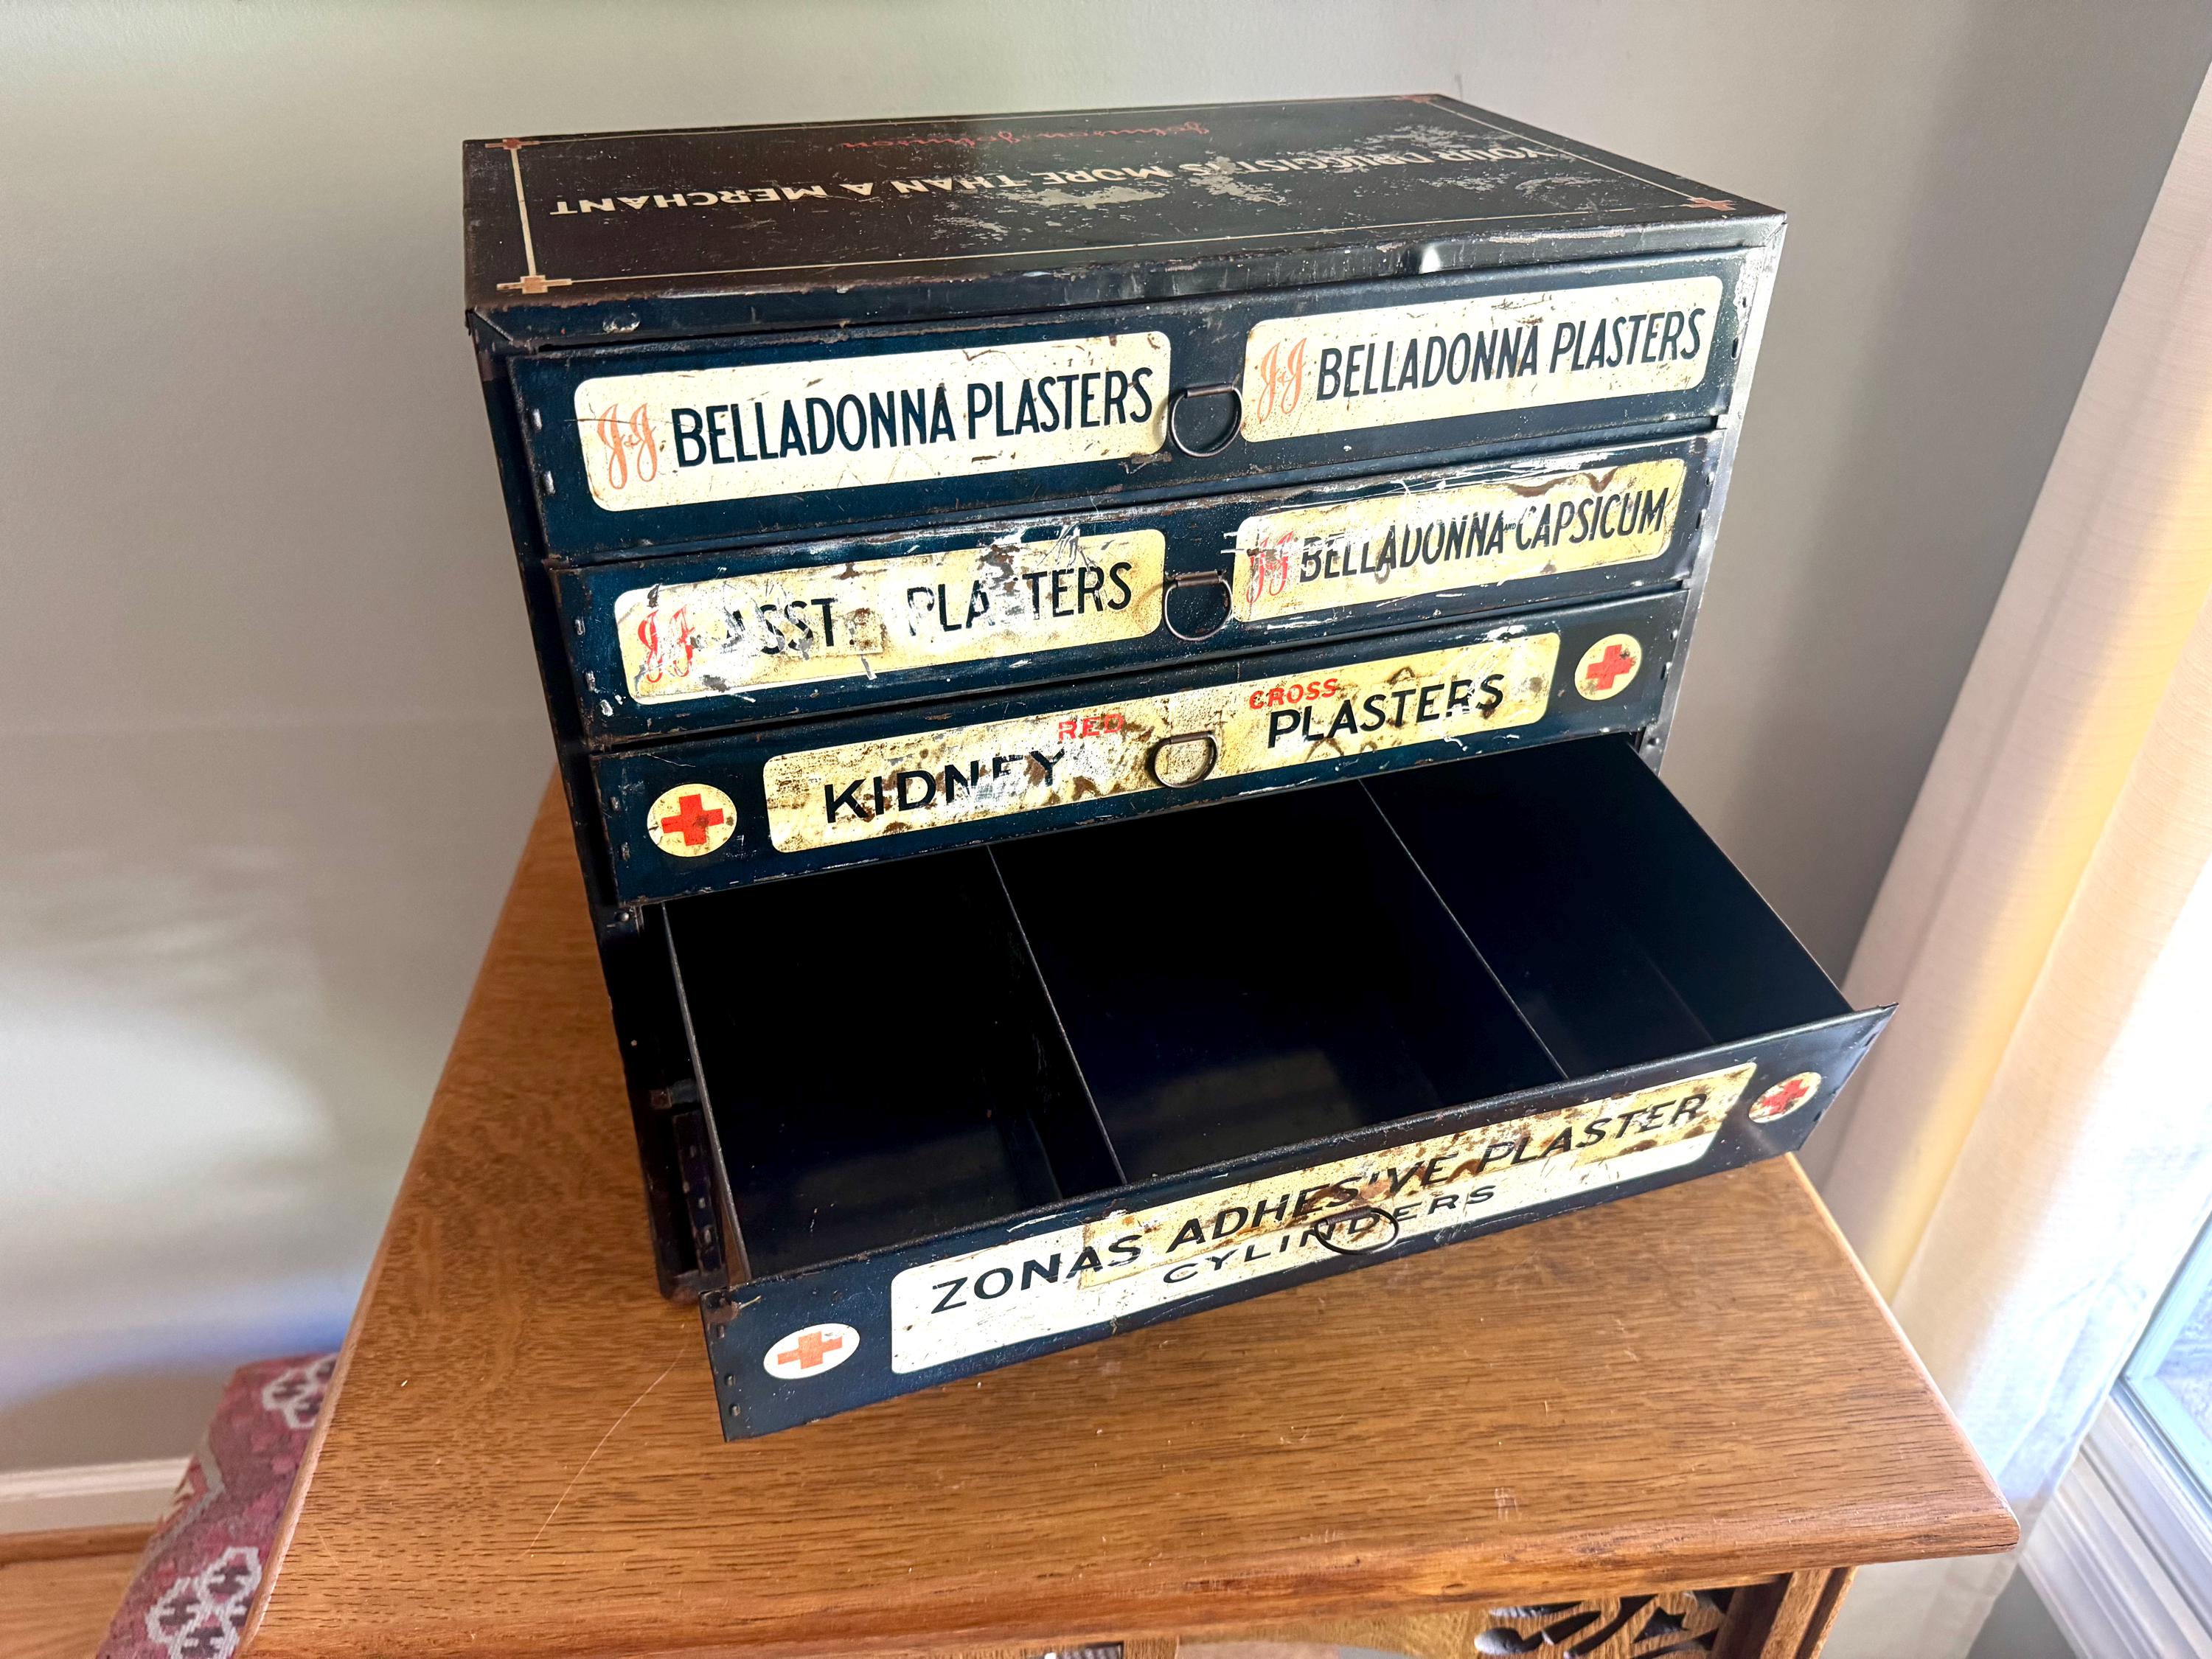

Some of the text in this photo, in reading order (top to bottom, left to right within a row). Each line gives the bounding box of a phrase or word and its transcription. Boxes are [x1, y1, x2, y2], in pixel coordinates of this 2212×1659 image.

[891, 174, 1028, 193] THAN
[1030, 165, 1175, 185] MORE
[1237, 151, 1435, 173] DRUGGIST
[1436, 147, 1557, 162] YOUR
[549, 186, 825, 215] MERCHANT
[838, 182, 874, 196] A
[1316, 324, 1537, 400] BELLADONNA
[1549, 307, 1705, 374] PLASTERS
[672, 386, 956, 467] BELLADONNA
[967, 367, 1153, 439] PLASTERS
[1300, 509, 1505, 583] BELLADONNA
[1515, 487, 1669, 551] CAPSICUM
[907, 561, 1133, 636] PLATERS
[1058, 678, 1338, 743] RED CROSS
[1267, 674, 1505, 748] PLASTERS
[931, 1234, 1143, 1314] ZONAS
[1476, 1093, 1708, 1174] PLASTER
